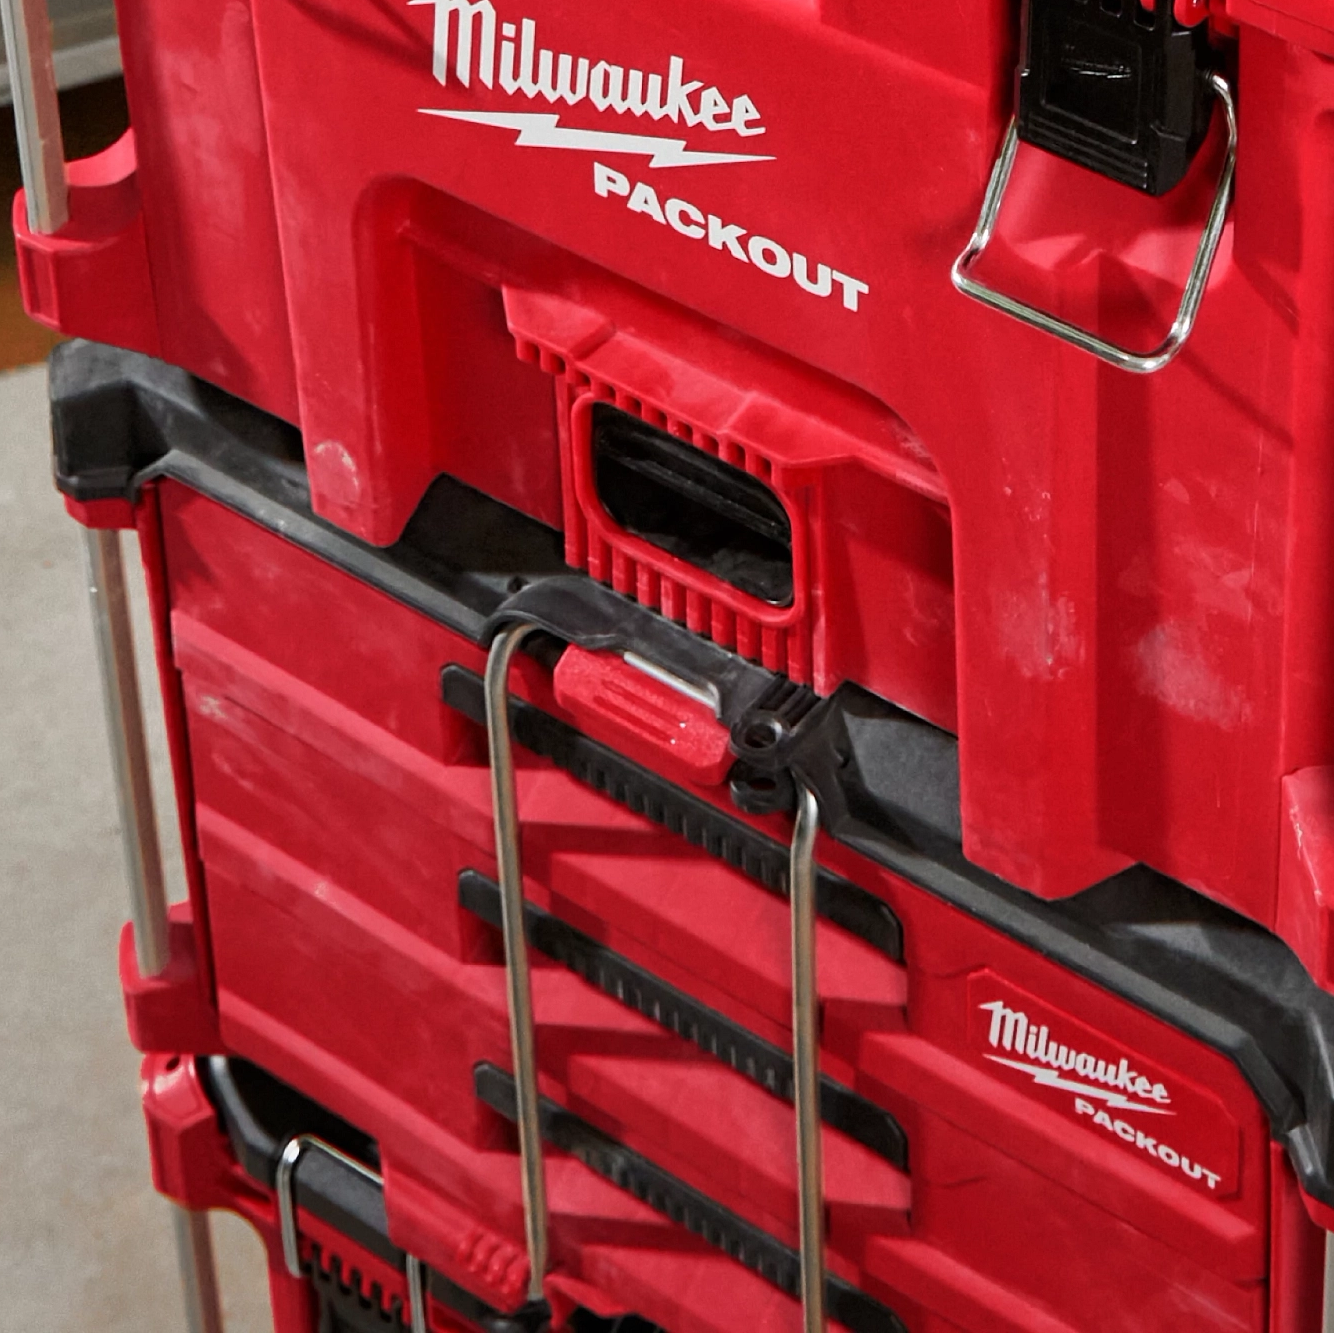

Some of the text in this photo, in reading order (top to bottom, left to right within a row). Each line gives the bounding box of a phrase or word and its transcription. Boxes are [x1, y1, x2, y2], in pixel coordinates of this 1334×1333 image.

[593, 161, 870, 313] PACKOUT
[978, 1000, 1172, 1104] Milwaukee
[1074, 1097, 1222, 1190] PACKOUT
